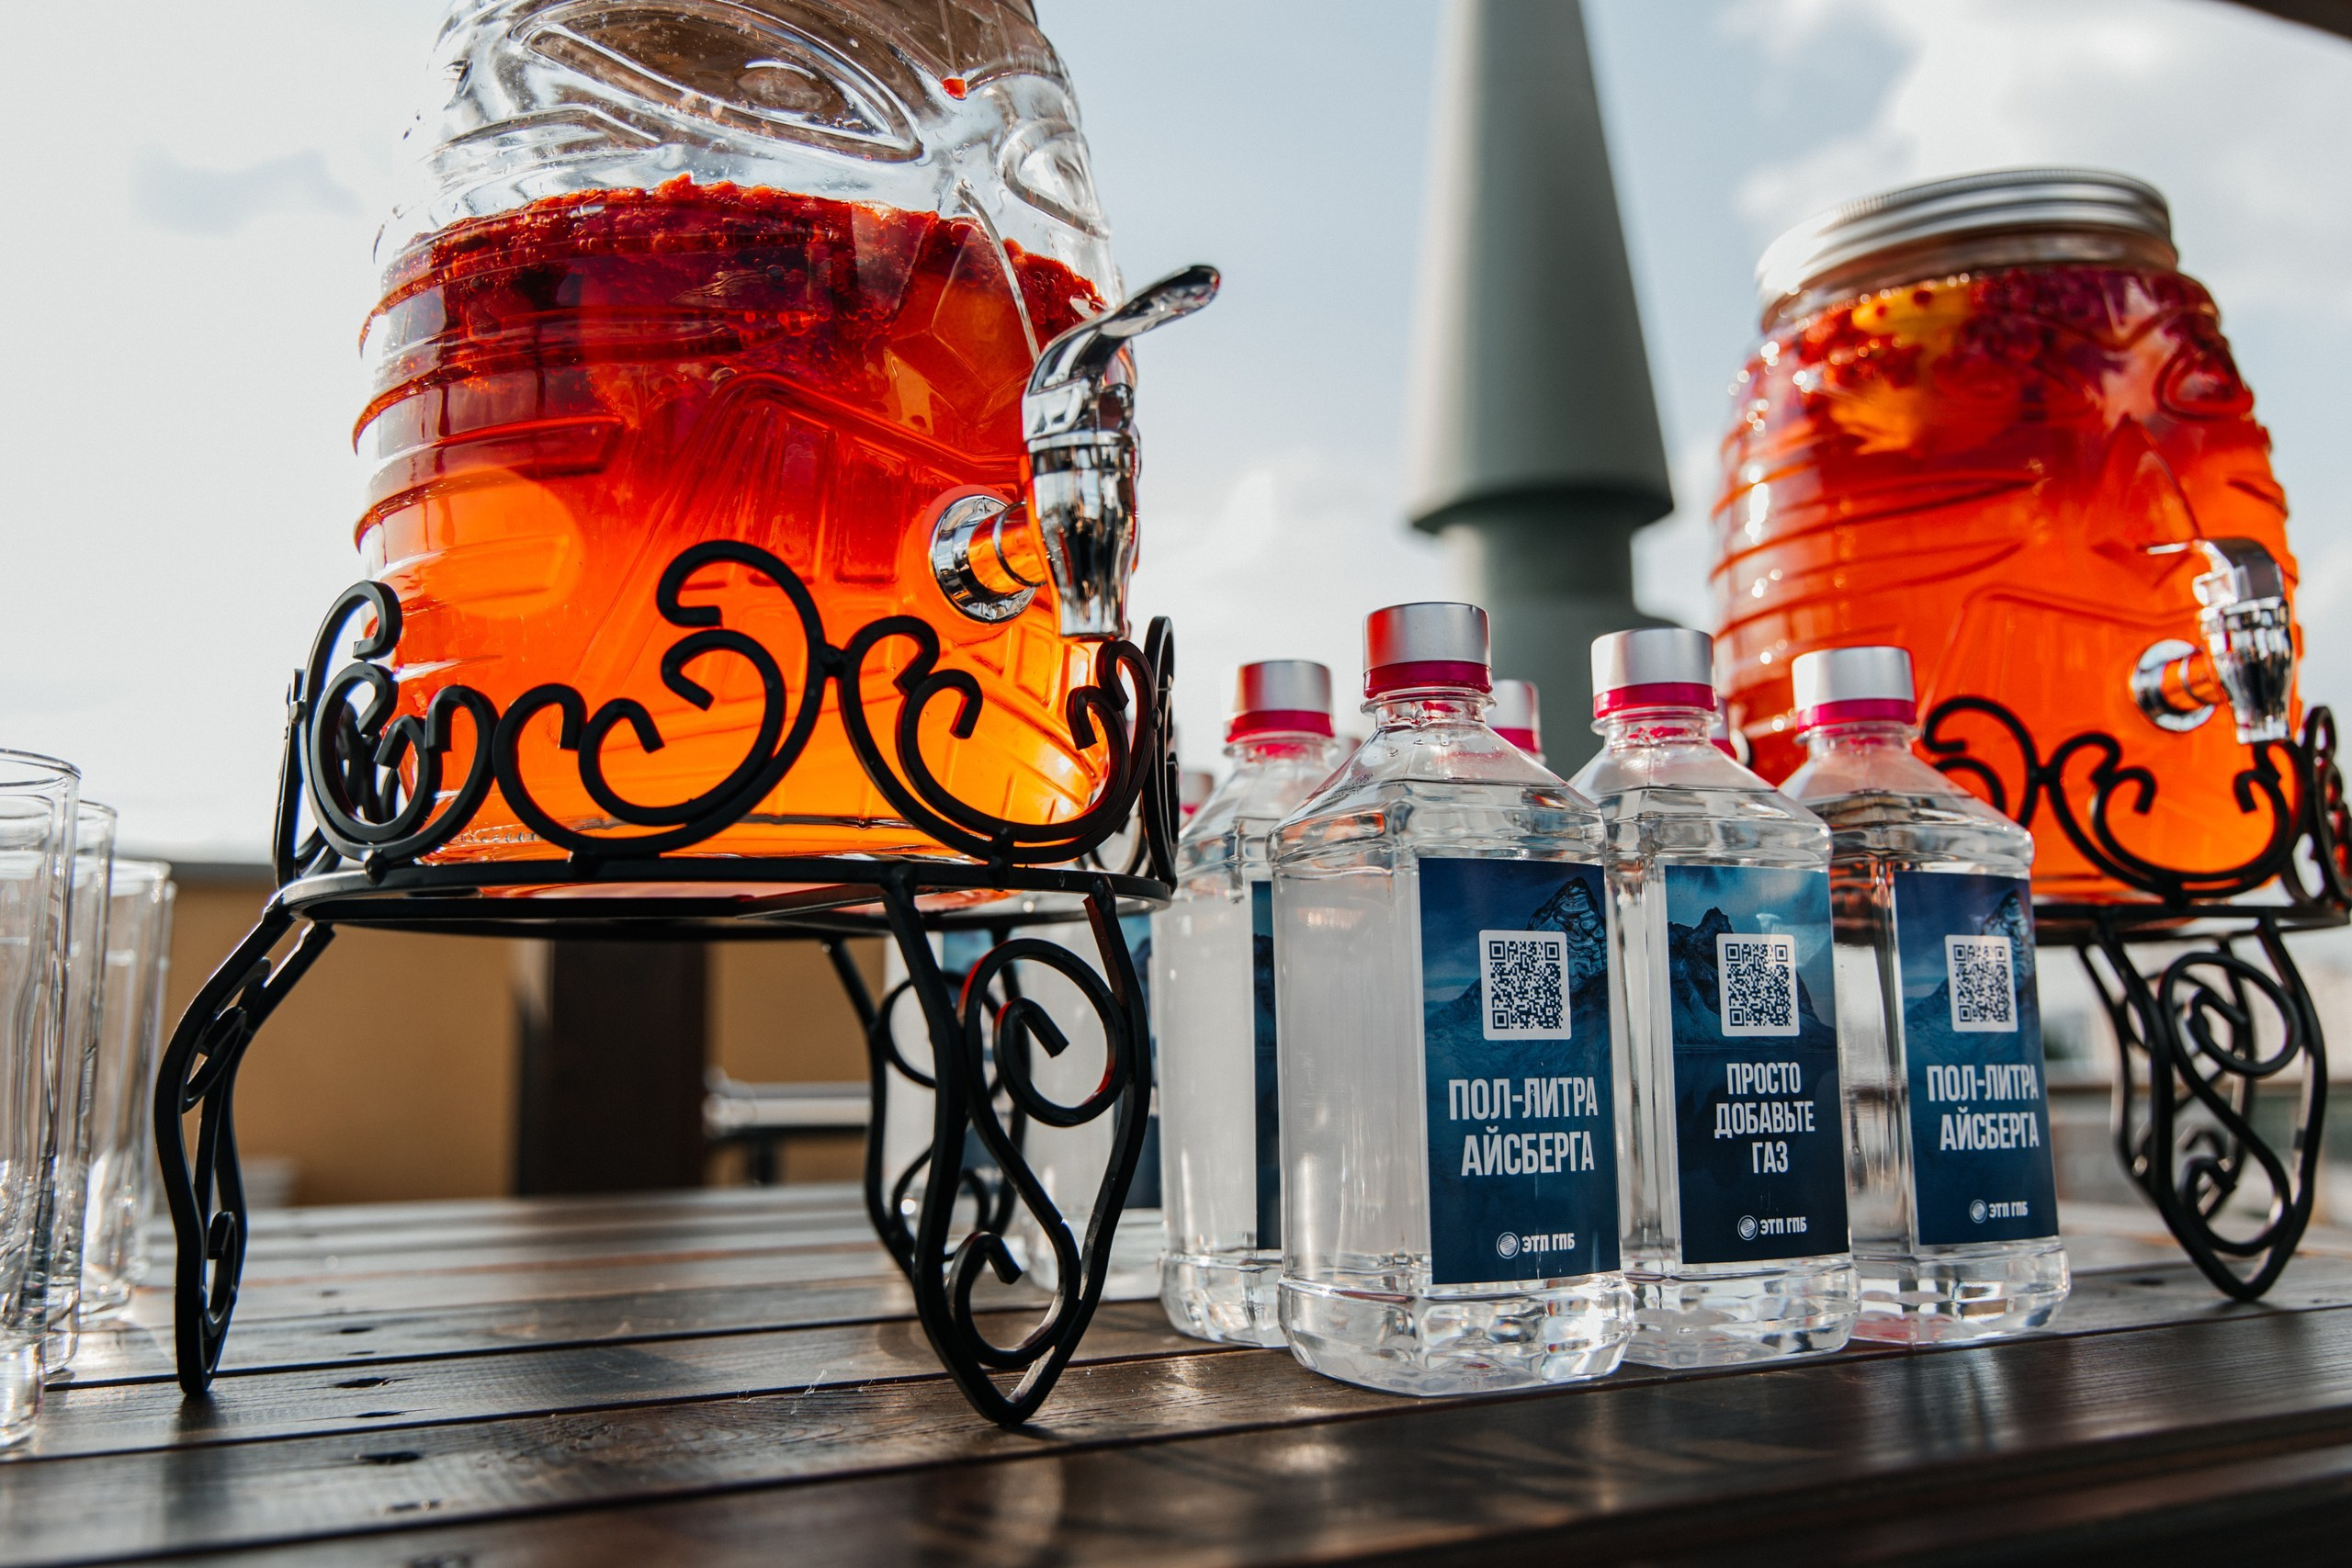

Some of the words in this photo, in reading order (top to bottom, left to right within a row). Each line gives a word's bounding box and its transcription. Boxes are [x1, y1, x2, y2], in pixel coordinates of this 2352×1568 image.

[1726, 1062, 1802, 1095] ПРОСТО
[1926, 1064, 2040, 1102] ПОЛ-ЛИТРА
[1448, 1077, 1599, 1121] ПОЛ-ЛИТРА
[1714, 1100, 1815, 1139] ДОБАВЬТЕ
[1939, 1106, 2040, 1151] АЙСБЕРГА
[1461, 1125, 1595, 1177] АЙСБЕРГА
[1751, 1141, 1789, 1174] ГАЗ
[1759, 1218, 1784, 1235] ЭТП
[1786, 1216, 1807, 1234] ГПБ
[1988, 1202, 2009, 1219] ЭТП
[2011, 1201, 2029, 1217] ГПБ
[1521, 1234, 1550, 1253] ЭТП
[1552, 1233, 1576, 1251] ГПБ
